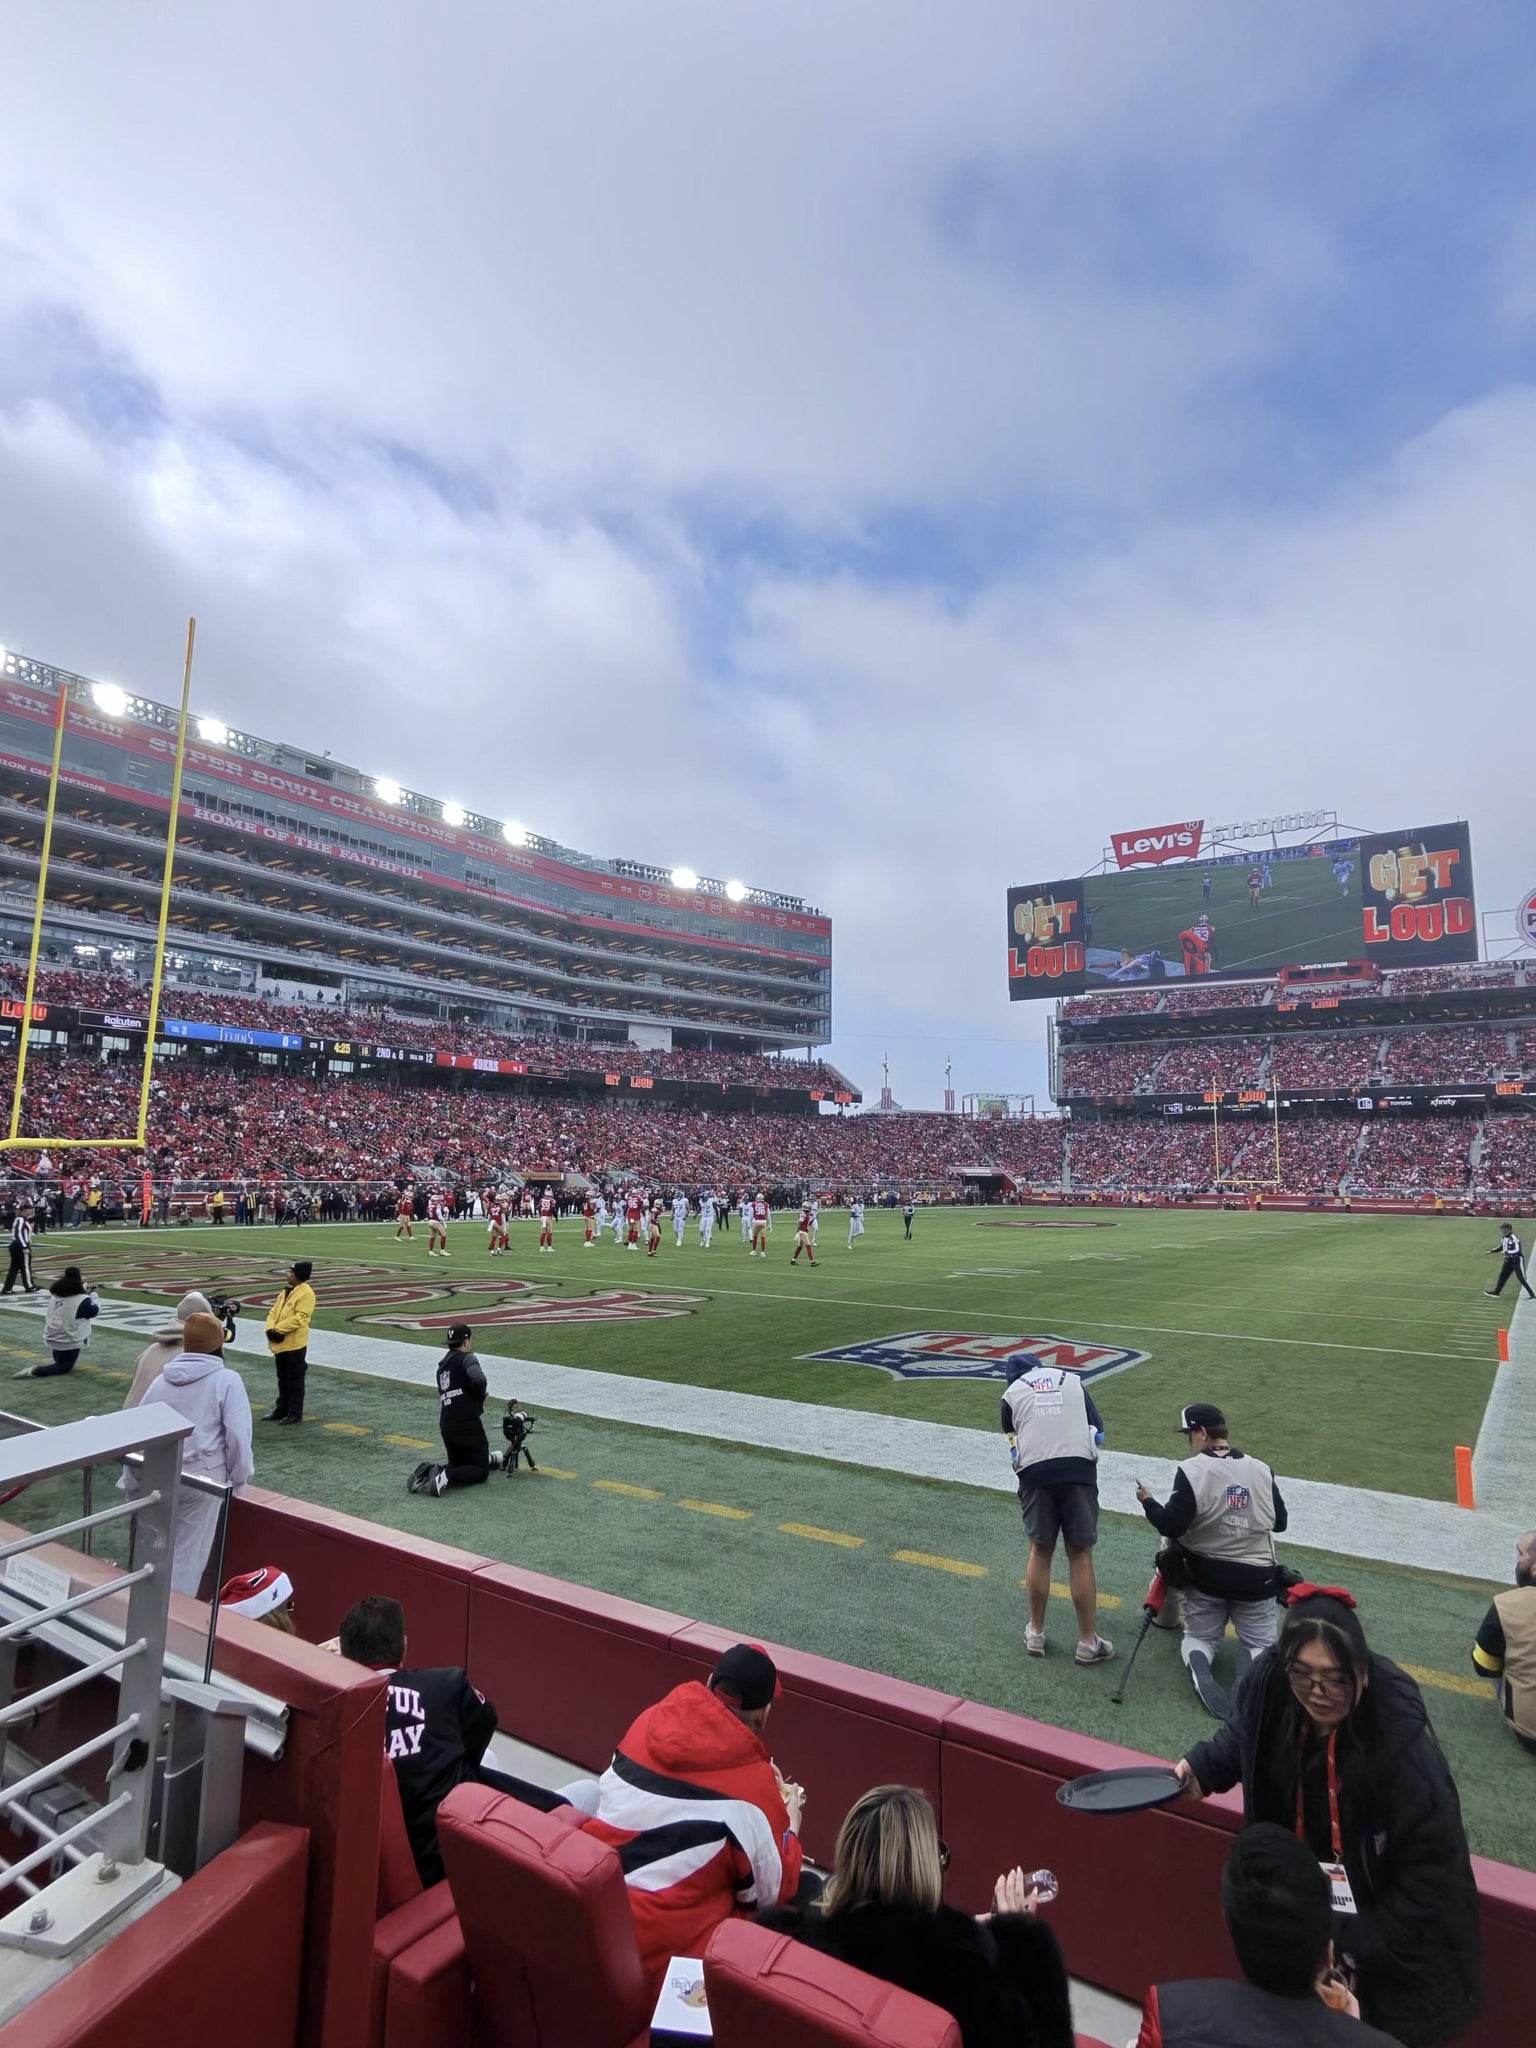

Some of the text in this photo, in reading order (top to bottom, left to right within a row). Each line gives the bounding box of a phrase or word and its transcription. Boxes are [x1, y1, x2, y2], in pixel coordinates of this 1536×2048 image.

[250, 768, 324, 803] BOWL
[329, 795, 457, 845] CHAMPIONS
[1210, 809, 1326, 844] STADIUM
[193, 806, 424, 881] HOME OF THE FAITHFUL
[1121, 832, 1194, 857] Levi's
[1369, 848, 1460, 895] GET
[1013, 899, 1078, 938] GET
[1362, 896, 1475, 944] LOUD
[1008, 940, 1085, 979] LOUD
[104, 1015, 142, 1028] Rakuten
[181, 1025, 188, 1036] 3
[282, 1035, 289, 1048] 0
[320, 1041, 324, 1052] 1
[333, 1042, 351, 1054] 4:25
[376, 1047, 391, 1059] 2ND
[398, 1050, 404, 1060] 6
[425, 1053, 434, 1064] 12
[451, 1056, 457, 1067] 7
[472, 1057, 500, 1073] 49ERS
[1495, 1082, 1525, 1096] GET
[1430, 1098, 1457, 1107] xfinity
[754, 1205, 766, 1215] 96
[909, 1333, 1110, 1369] NFL
[1034, 1381, 1052, 1391] NFL
[1229, 1495, 1248, 1508] NFL
